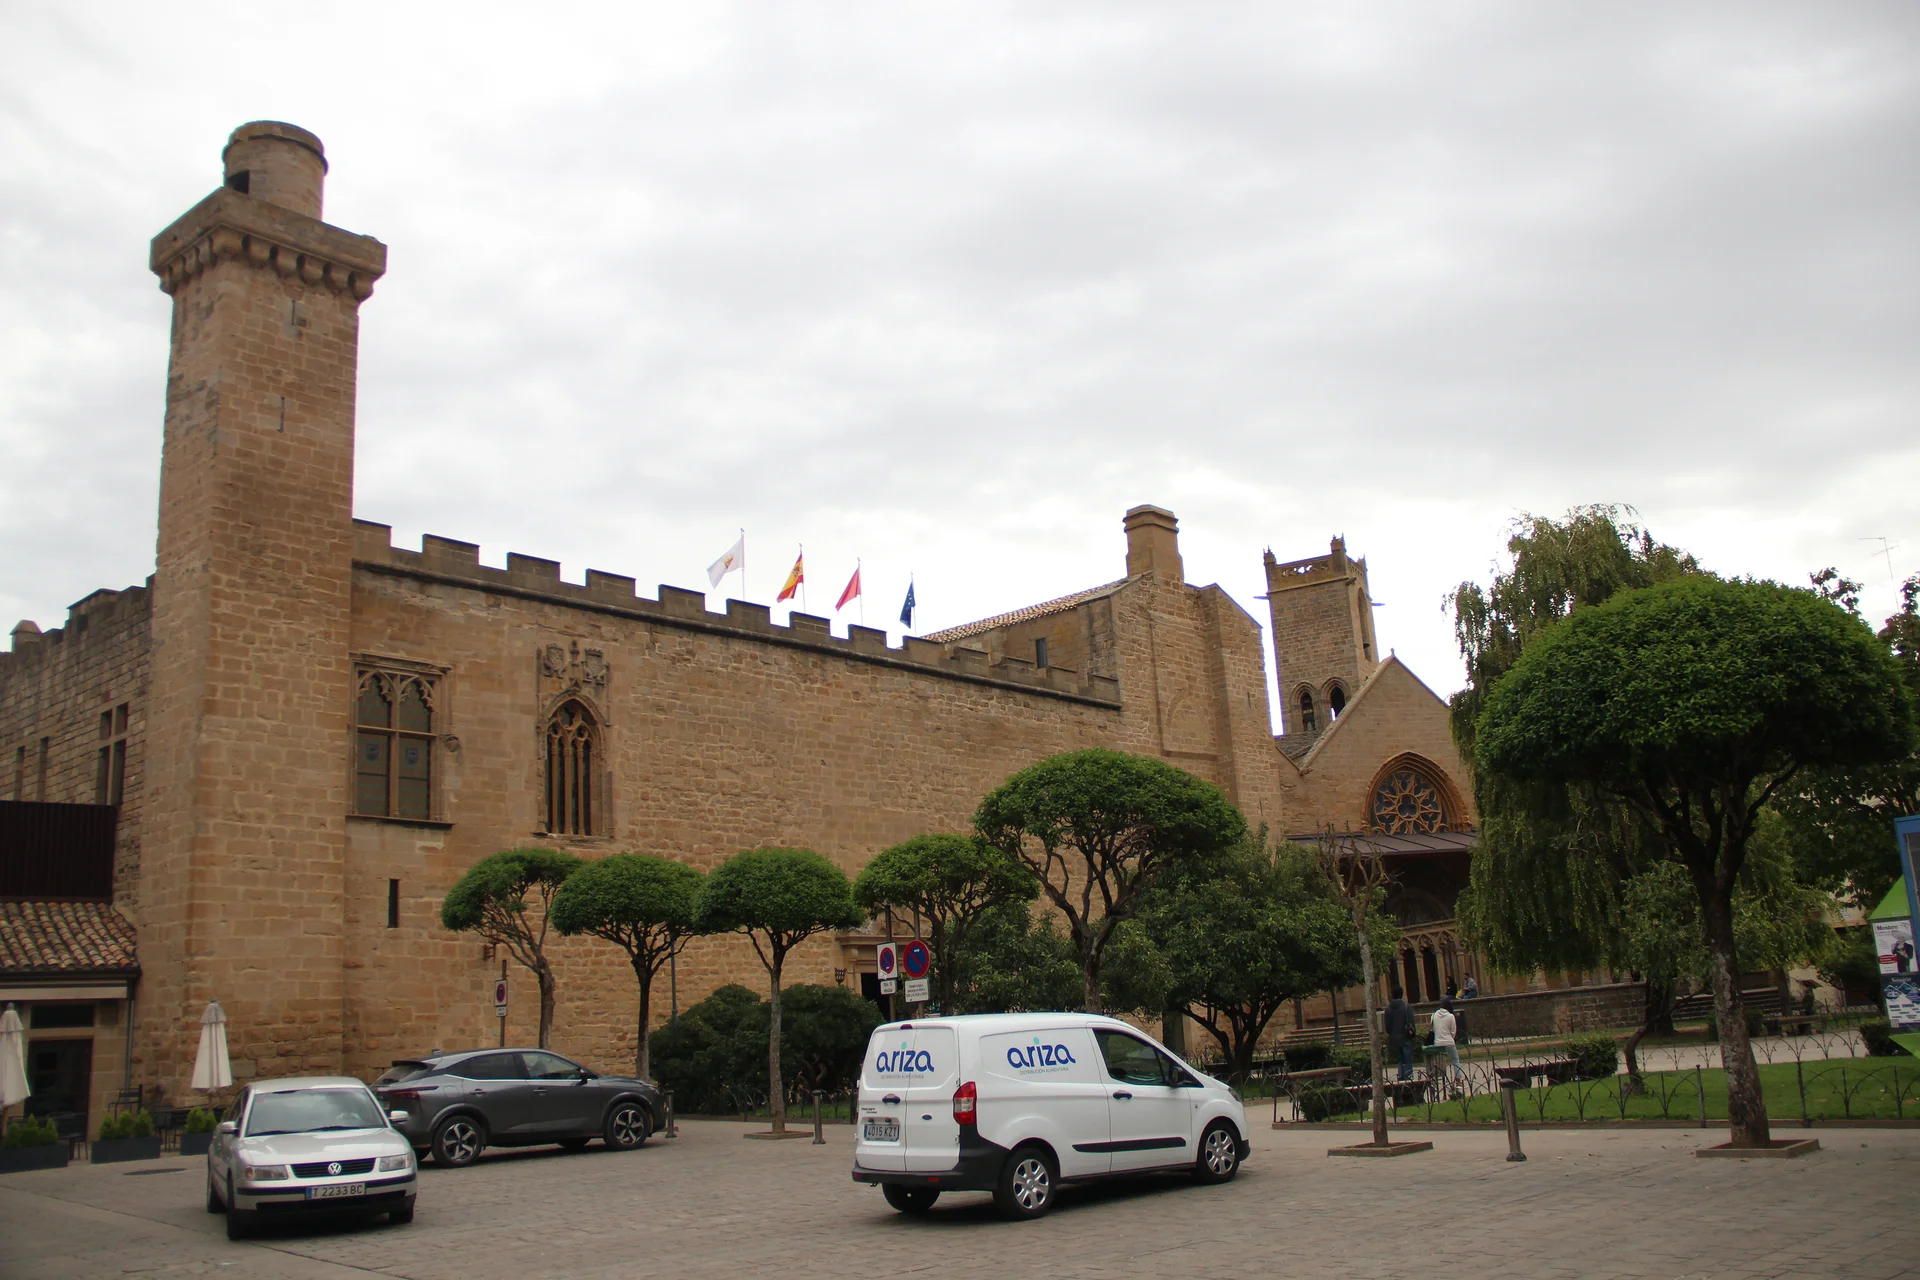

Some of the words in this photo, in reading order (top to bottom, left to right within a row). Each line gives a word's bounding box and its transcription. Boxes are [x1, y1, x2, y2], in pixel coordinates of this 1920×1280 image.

[876, 1041, 935, 1073] ariza
[1007, 1036, 1076, 1069] ariza
[867, 1126, 884, 1137] 4015
[884, 1126, 898, 1138] KZT
[313, 1187, 319, 1198] T
[322, 1186, 348, 1197] 2233
[350, 1184, 363, 1195] BC
